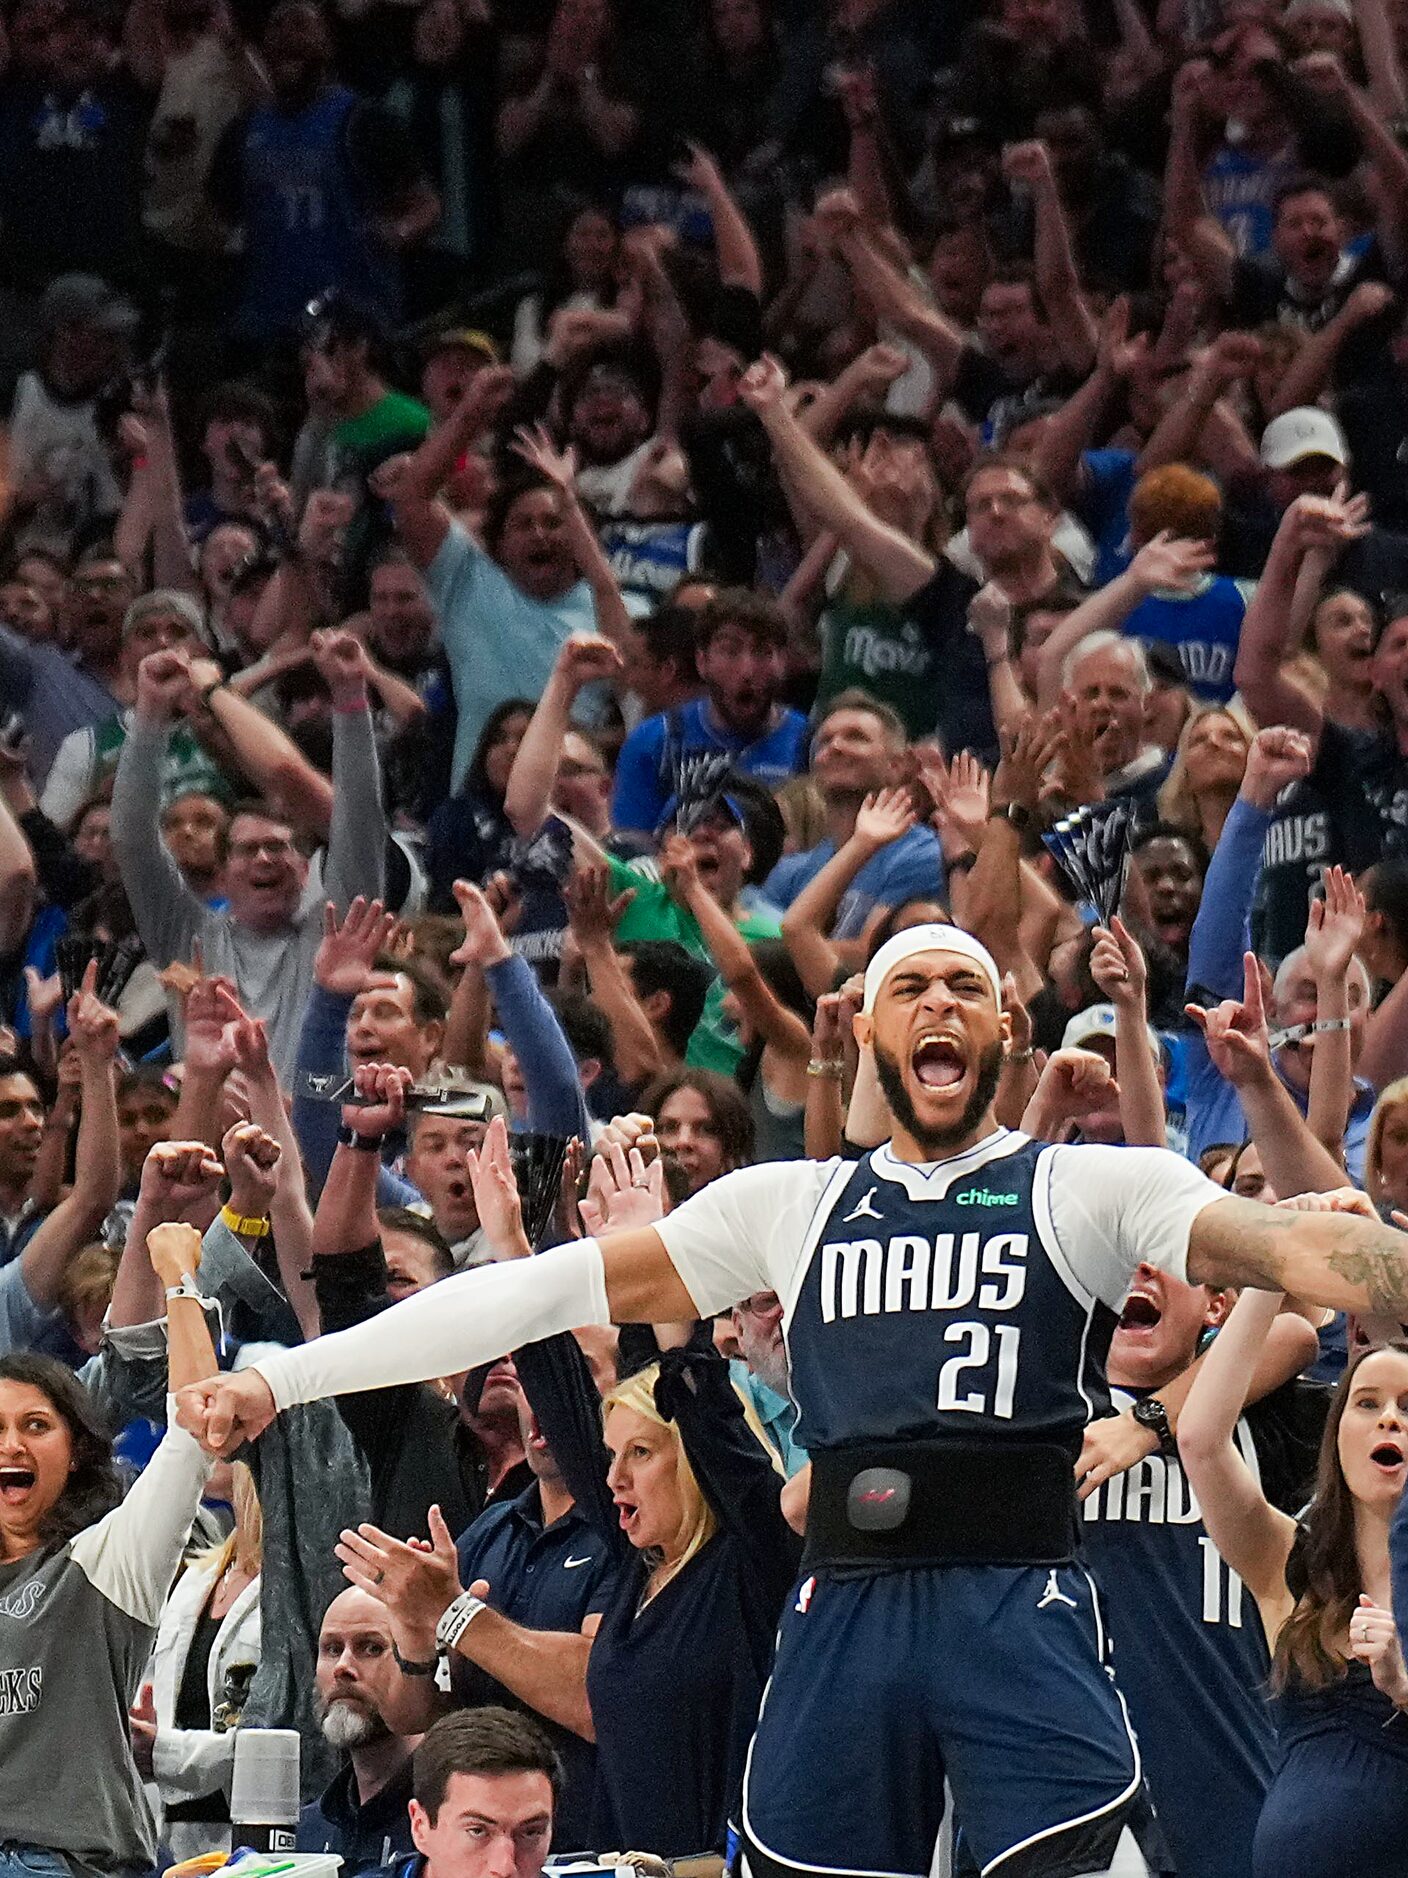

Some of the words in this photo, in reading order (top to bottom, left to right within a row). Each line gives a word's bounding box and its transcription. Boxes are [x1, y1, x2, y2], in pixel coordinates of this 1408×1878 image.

[956, 1188, 1018, 1207] chime
[821, 1231, 1029, 1324] MAVS
[937, 1320, 1021, 1420] 21
